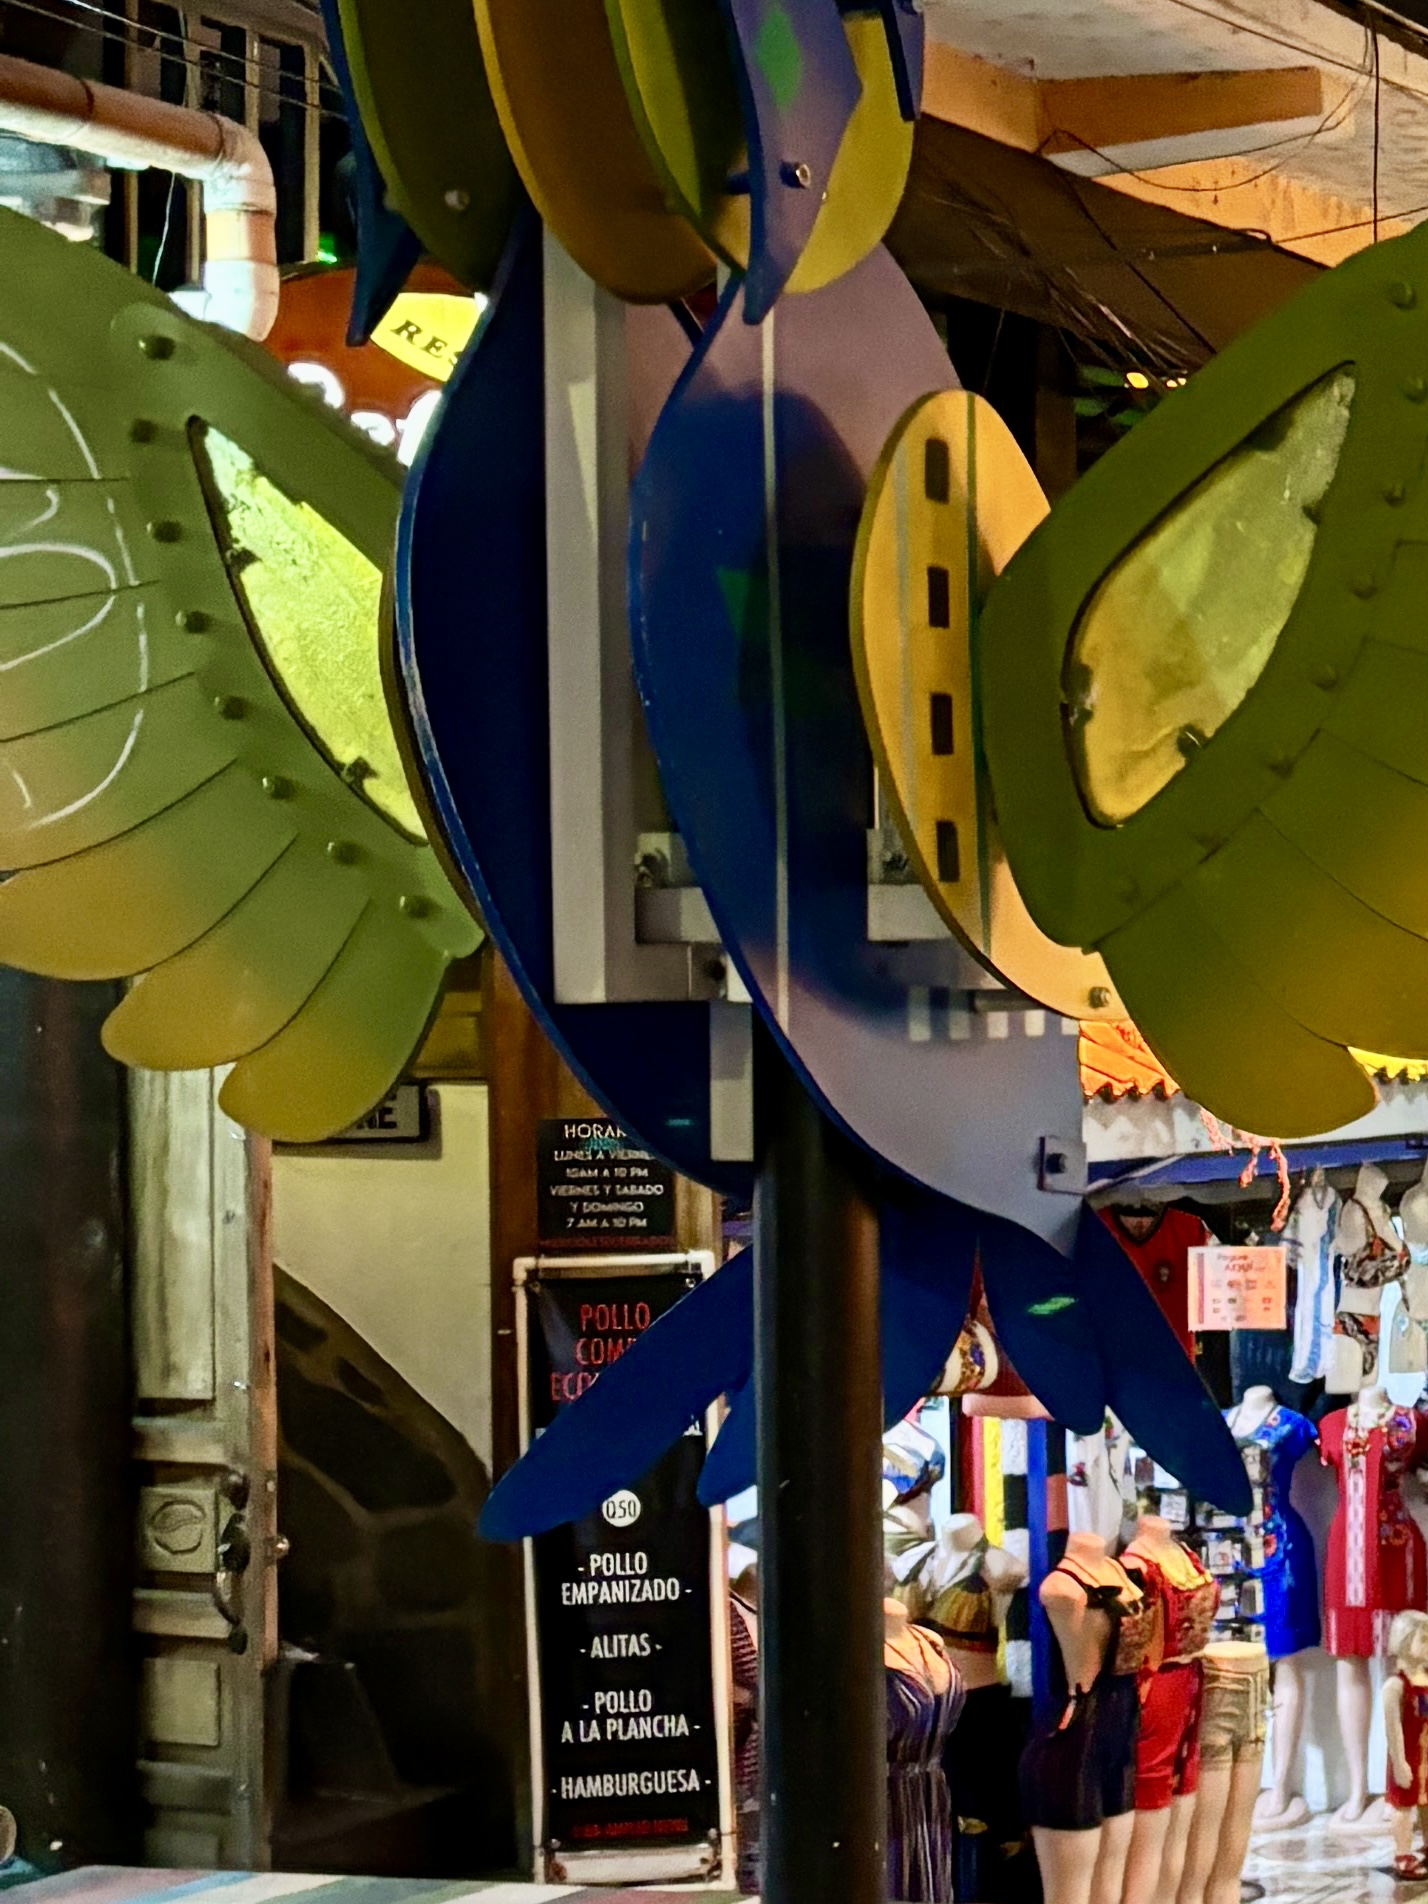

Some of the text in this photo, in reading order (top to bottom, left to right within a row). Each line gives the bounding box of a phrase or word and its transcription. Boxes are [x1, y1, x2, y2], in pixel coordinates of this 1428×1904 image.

[602, 1168, 611, 1177] A
[630, 1167, 649, 1177] PM
[603, 1185, 612, 1195] Y
[570, 1201, 644, 1213] Y DOMINGO
[576, 1218, 598, 1228] AM
[628, 1217, 648, 1227] PM
[580, 1302, 651, 1331] POLLO
[606, 1499, 637, 1519] Q50
[589, 1551, 648, 1577] POLLO
[561, 1577, 681, 1606] EMPANIZADO
[590, 1633, 652, 1659] ALITAS
[594, 1689, 652, 1714] POLLO
[561, 1713, 690, 1744] A LA PLANCHA
[560, 1768, 701, 1800] HAMBURGUESA
